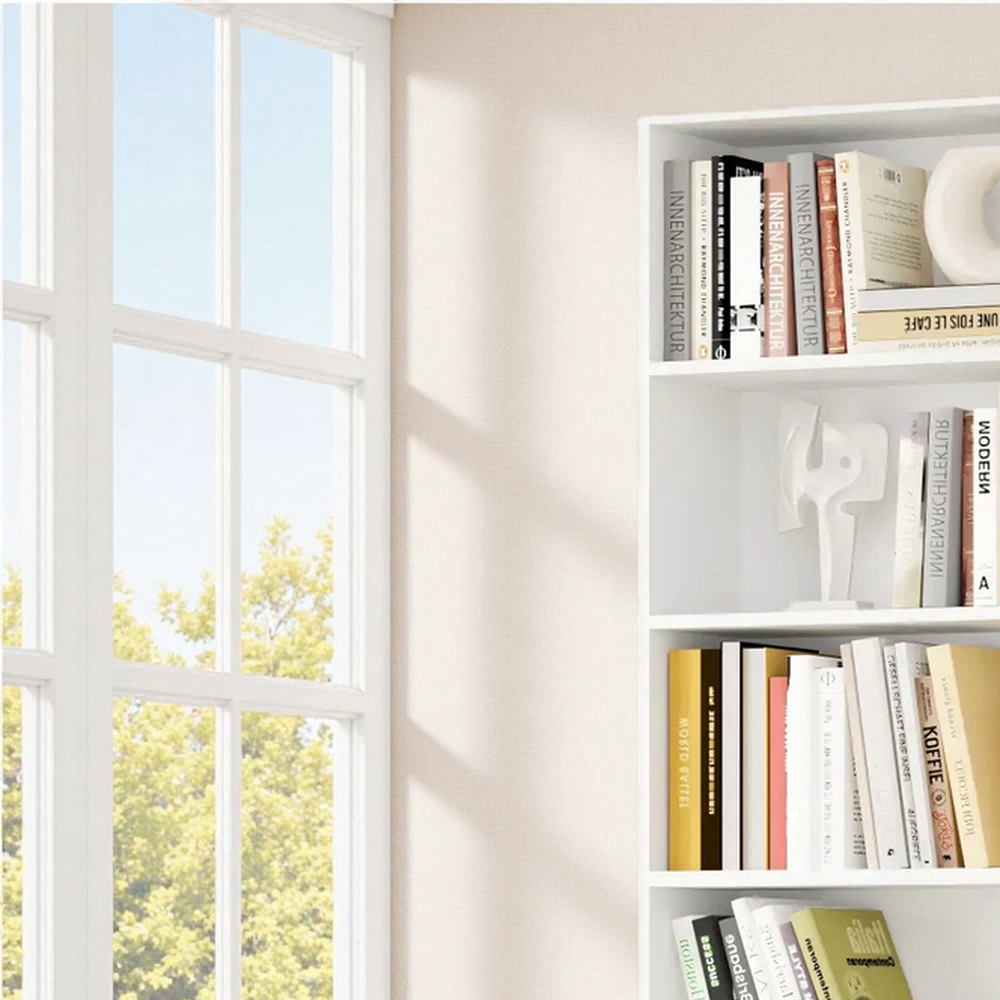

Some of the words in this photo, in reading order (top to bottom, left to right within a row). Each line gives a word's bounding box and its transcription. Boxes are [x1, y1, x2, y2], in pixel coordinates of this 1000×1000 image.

[670, 191, 685, 354] INNENARCHITEKTUR
[769, 192, 785, 351] INNENARCHITEKTUR
[796, 184, 820, 348] INNENARCHITEKTUR
[903, 314, 932, 335] CAFÉ
[934, 313, 947, 330] LE
[950, 312, 974, 329] FOIS
[976, 311, 999, 328] UNE
[979, 576, 990, 590] A
[923, 726, 944, 784] KOFFIE
